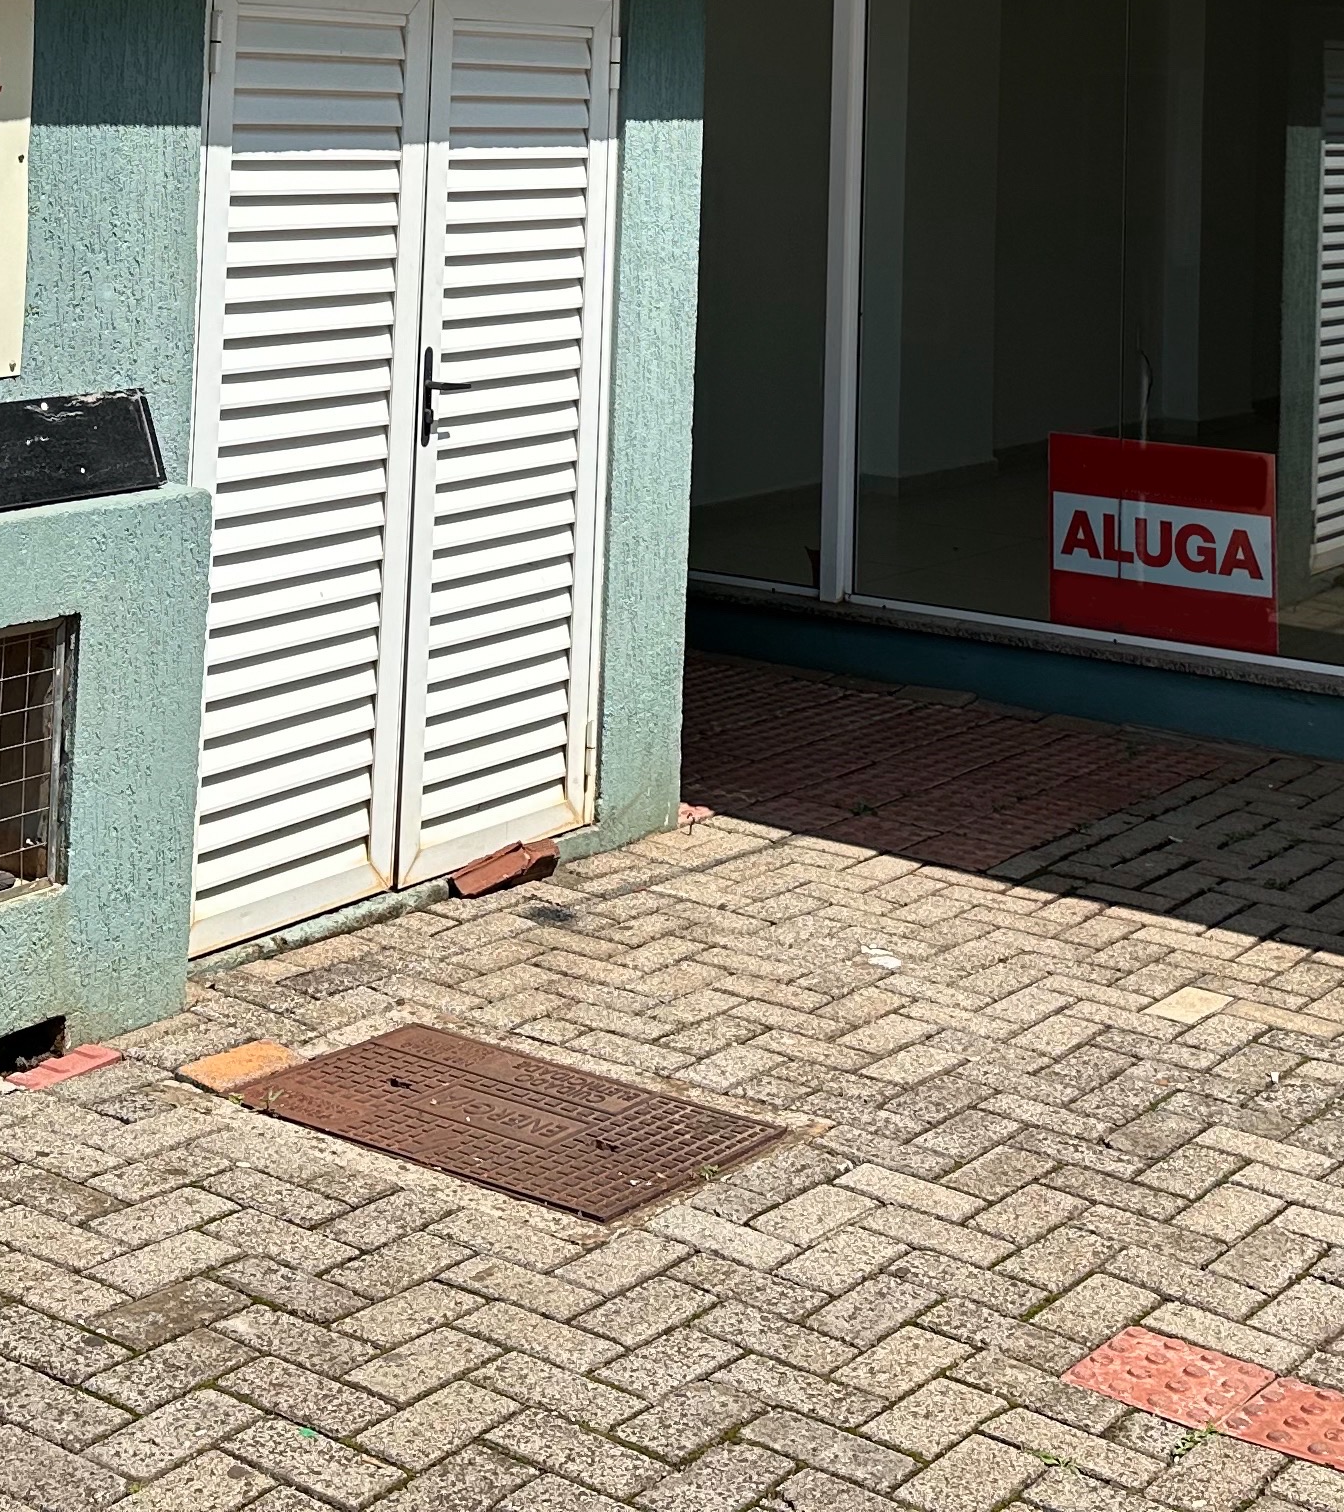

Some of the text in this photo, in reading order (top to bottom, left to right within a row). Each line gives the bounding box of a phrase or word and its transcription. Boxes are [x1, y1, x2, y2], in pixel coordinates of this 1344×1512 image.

[1060, 509, 1264, 581] ALUGA
[513, 1073, 607, 1104] CUIDADO
[436, 1095, 570, 1138] ENERGIA
